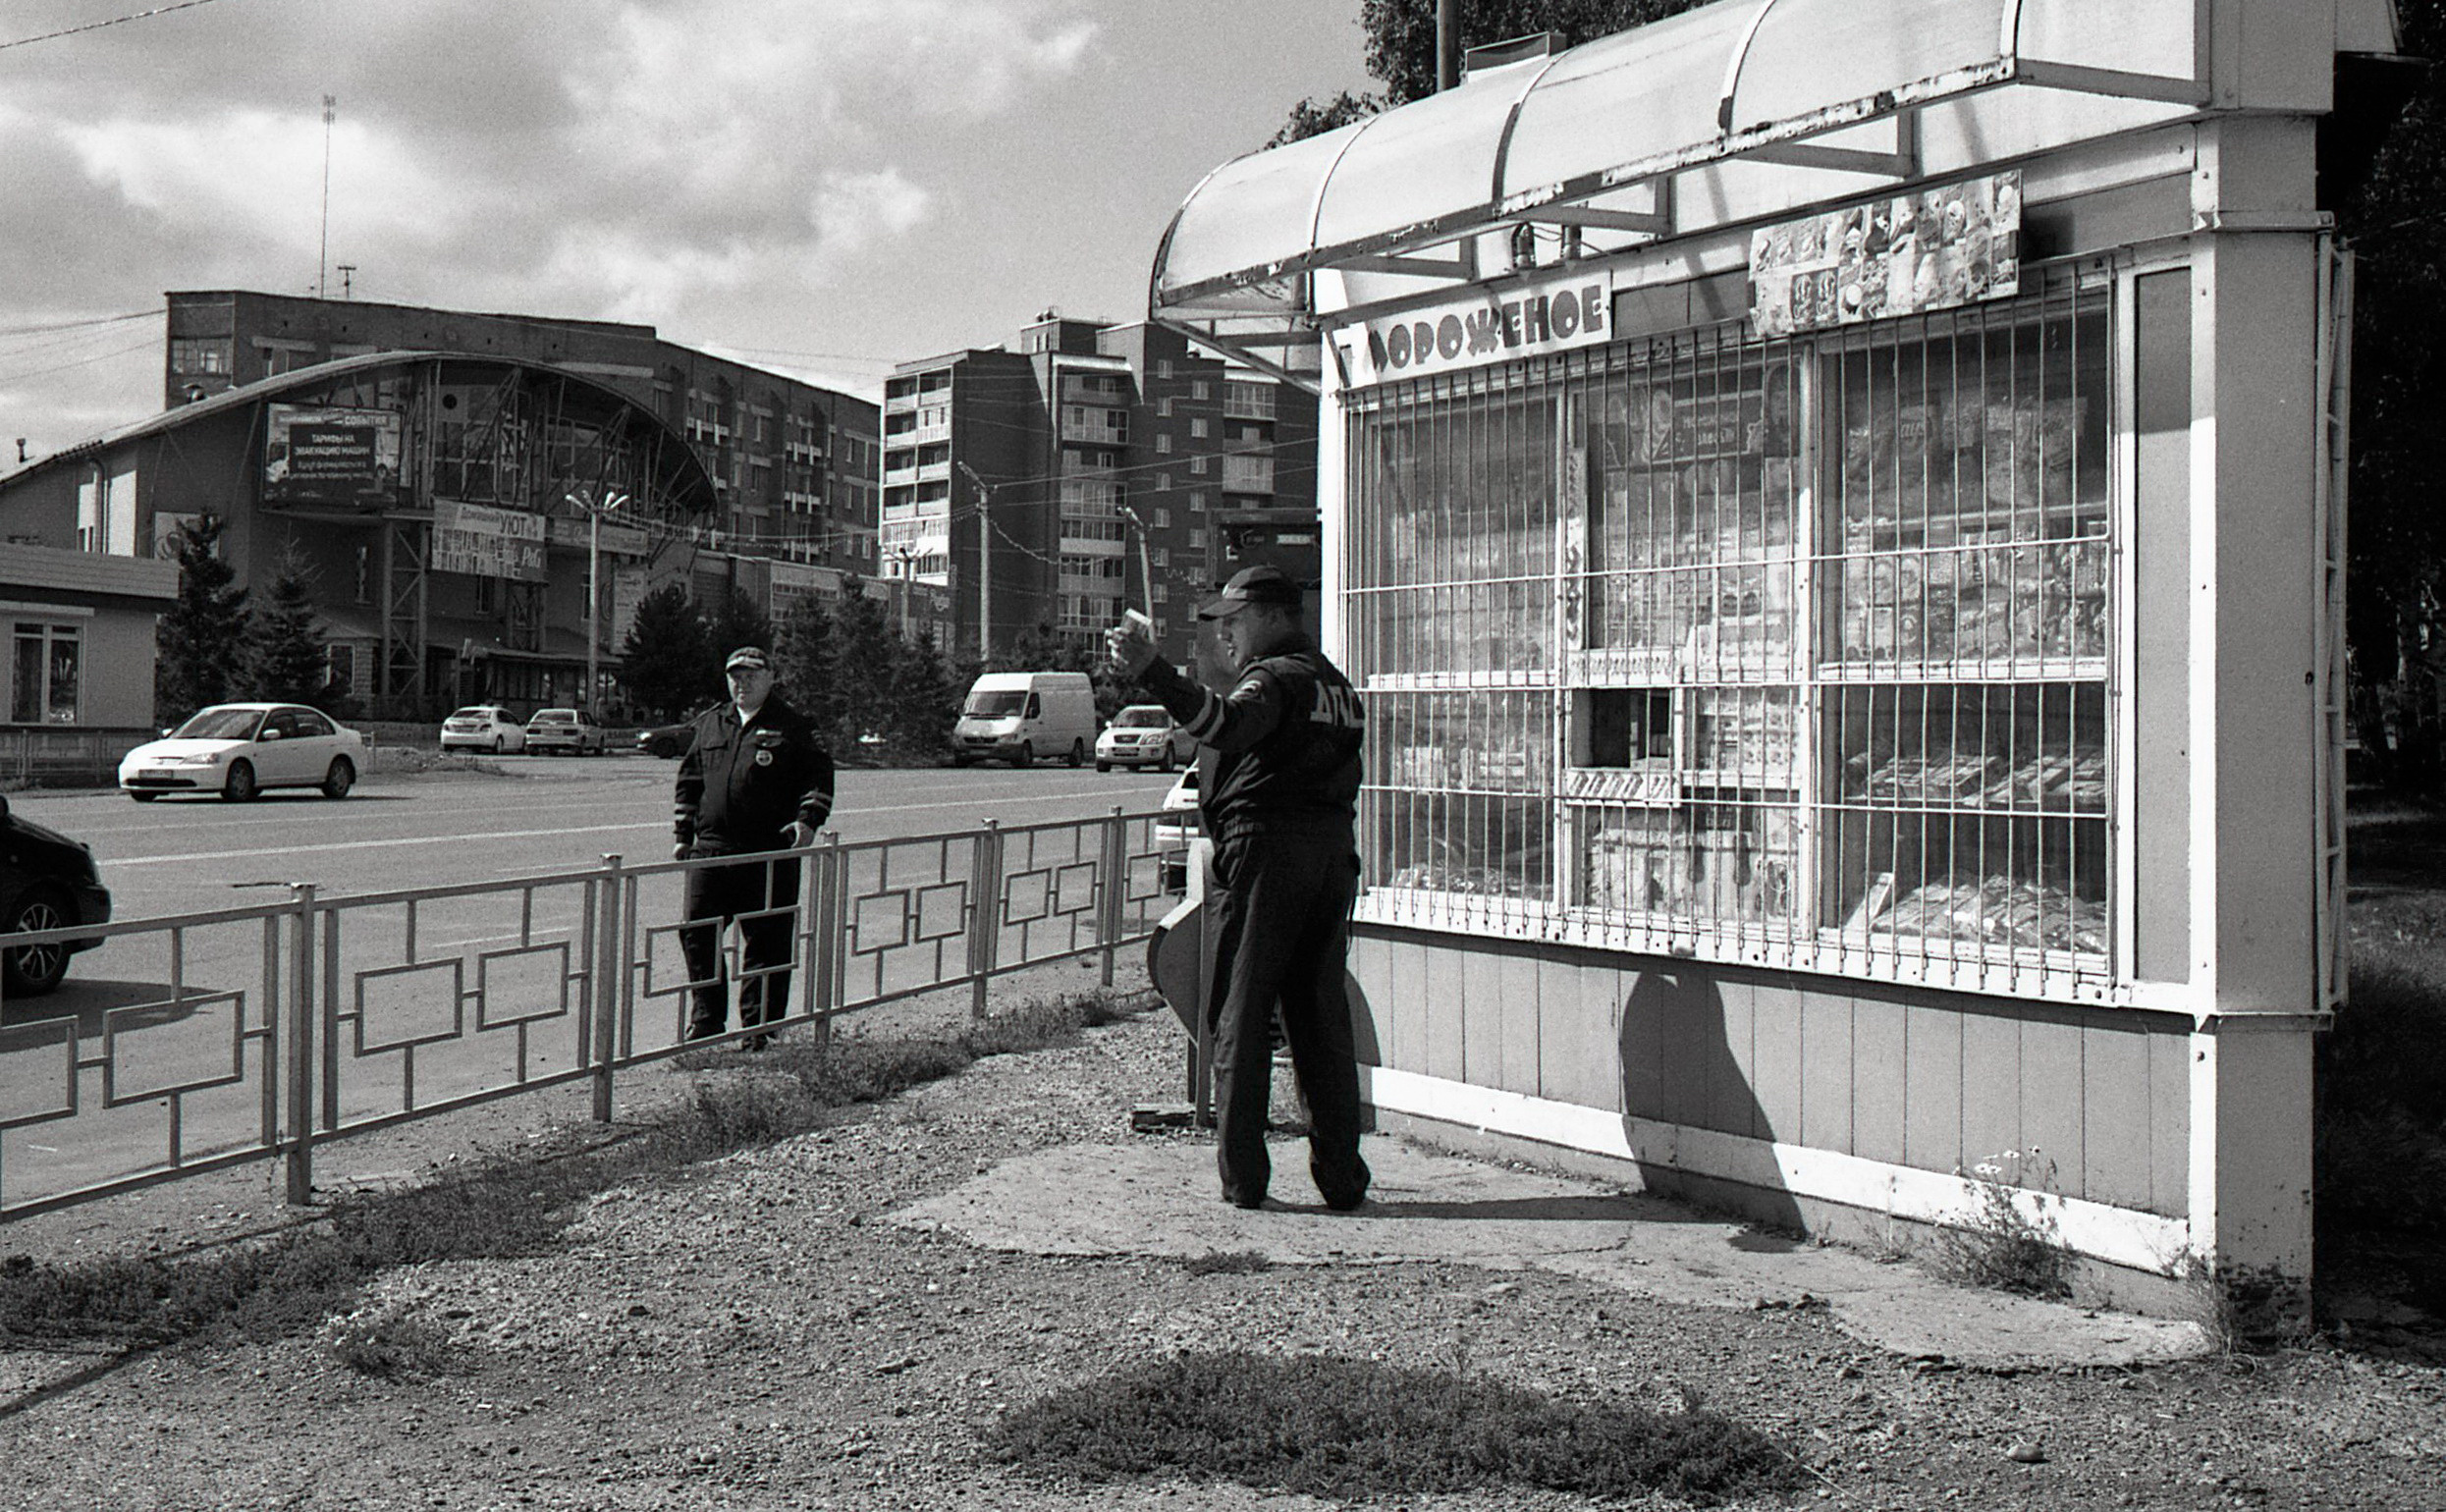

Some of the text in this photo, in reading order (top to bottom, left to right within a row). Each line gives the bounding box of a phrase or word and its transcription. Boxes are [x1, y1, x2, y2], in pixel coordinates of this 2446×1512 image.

[344, 413, 389, 426] СОБЫТИЯ
[311, 433, 355, 444] ТАРИФЫ НА
[294, 446, 371, 457] ЭВАКУАЦИЮ МАШИН
[499, 513, 528, 536] УЮТ
